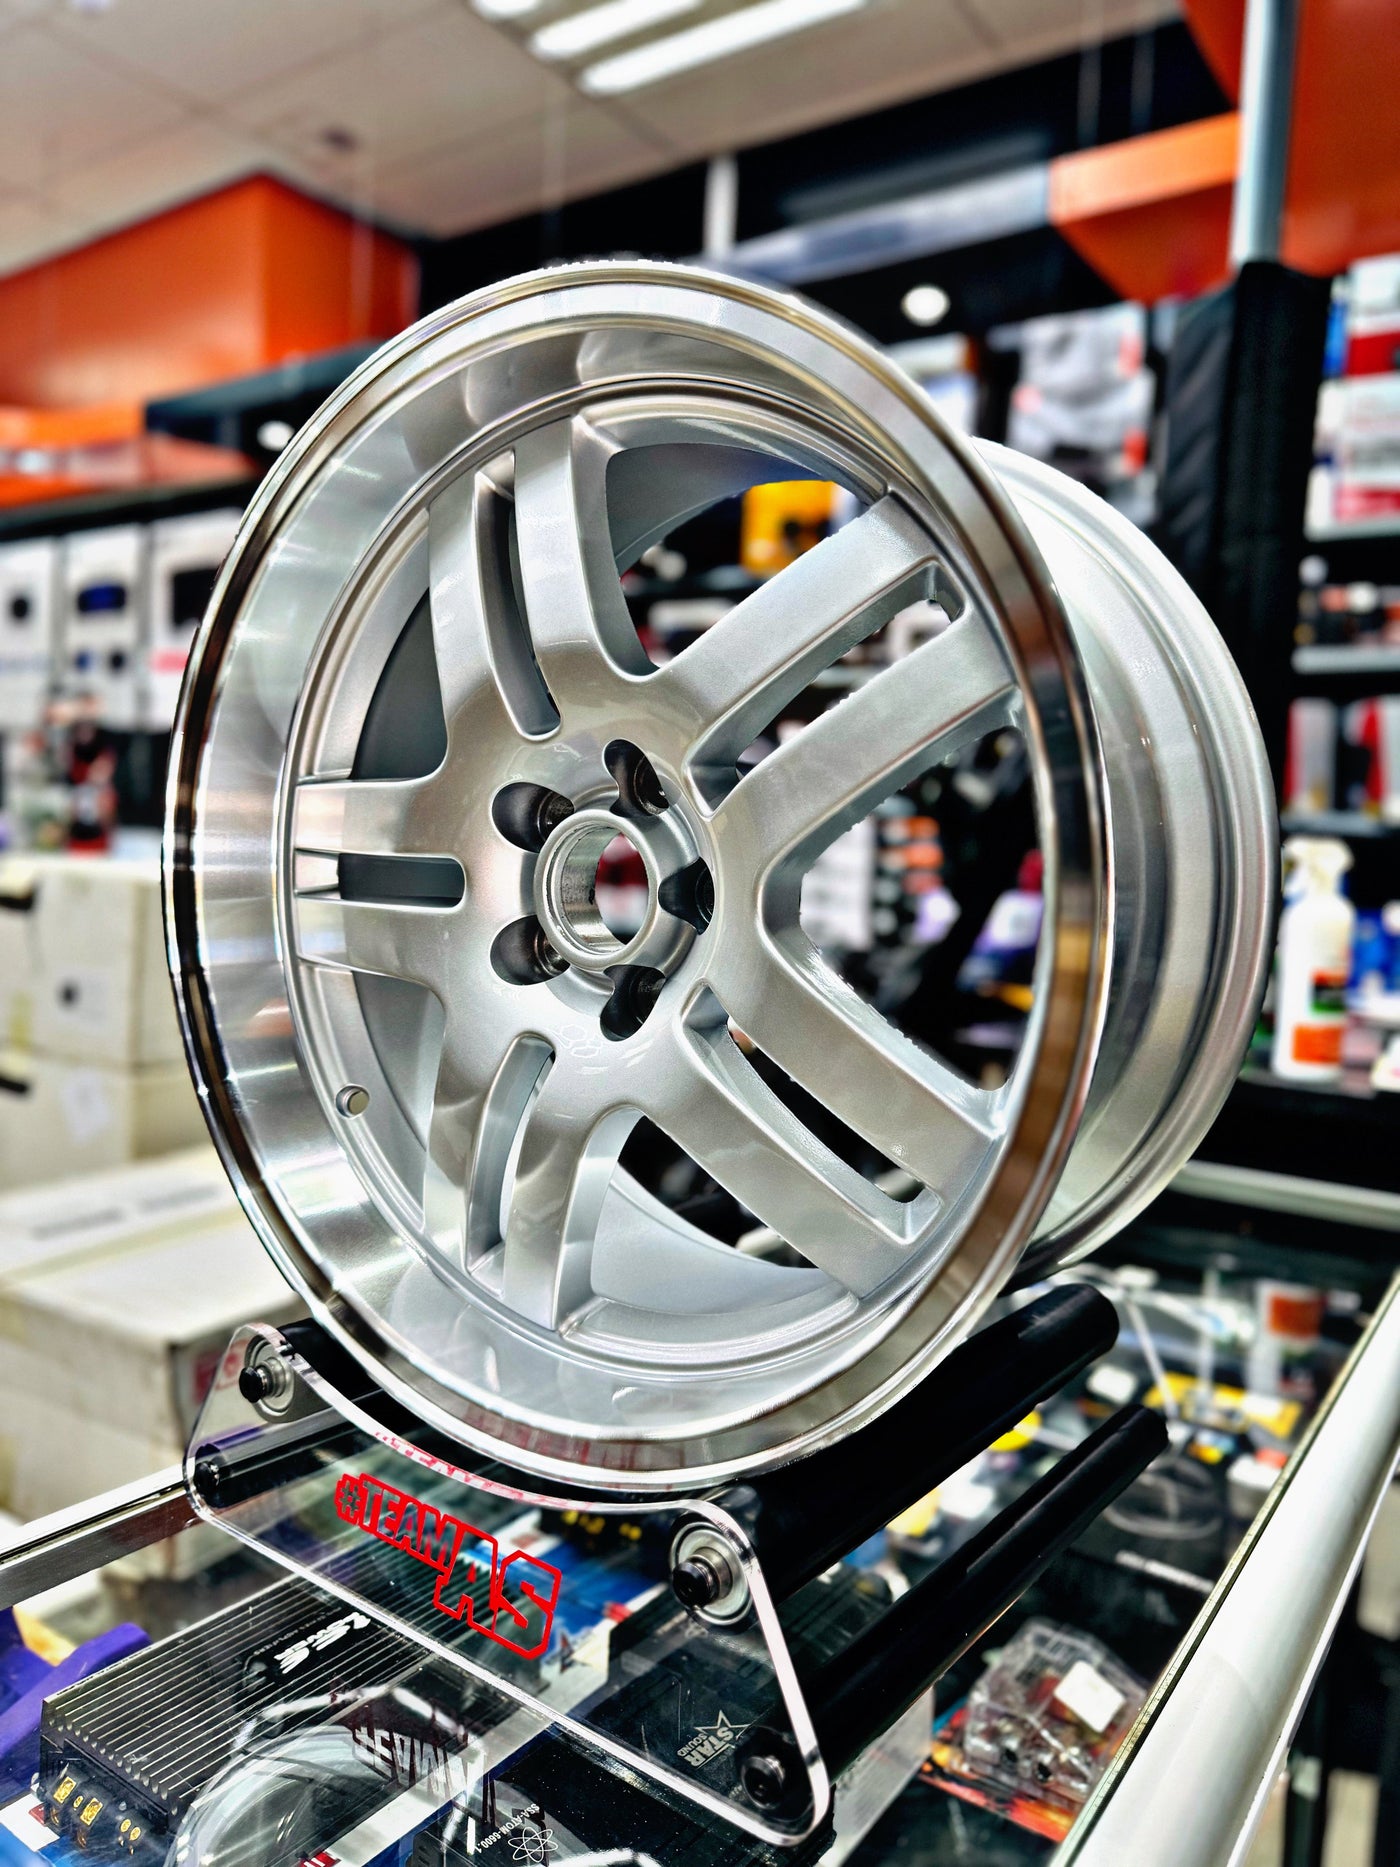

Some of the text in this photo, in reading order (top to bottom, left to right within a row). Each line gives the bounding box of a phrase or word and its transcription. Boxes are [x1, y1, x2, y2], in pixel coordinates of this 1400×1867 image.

[335, 1473, 562, 1661] #TEAM AS
[676, 1732, 708, 1757] SOUND
[684, 1726, 734, 1767] STAR
[474, 1803, 540, 1853] SSA-ATOM-6600.1
